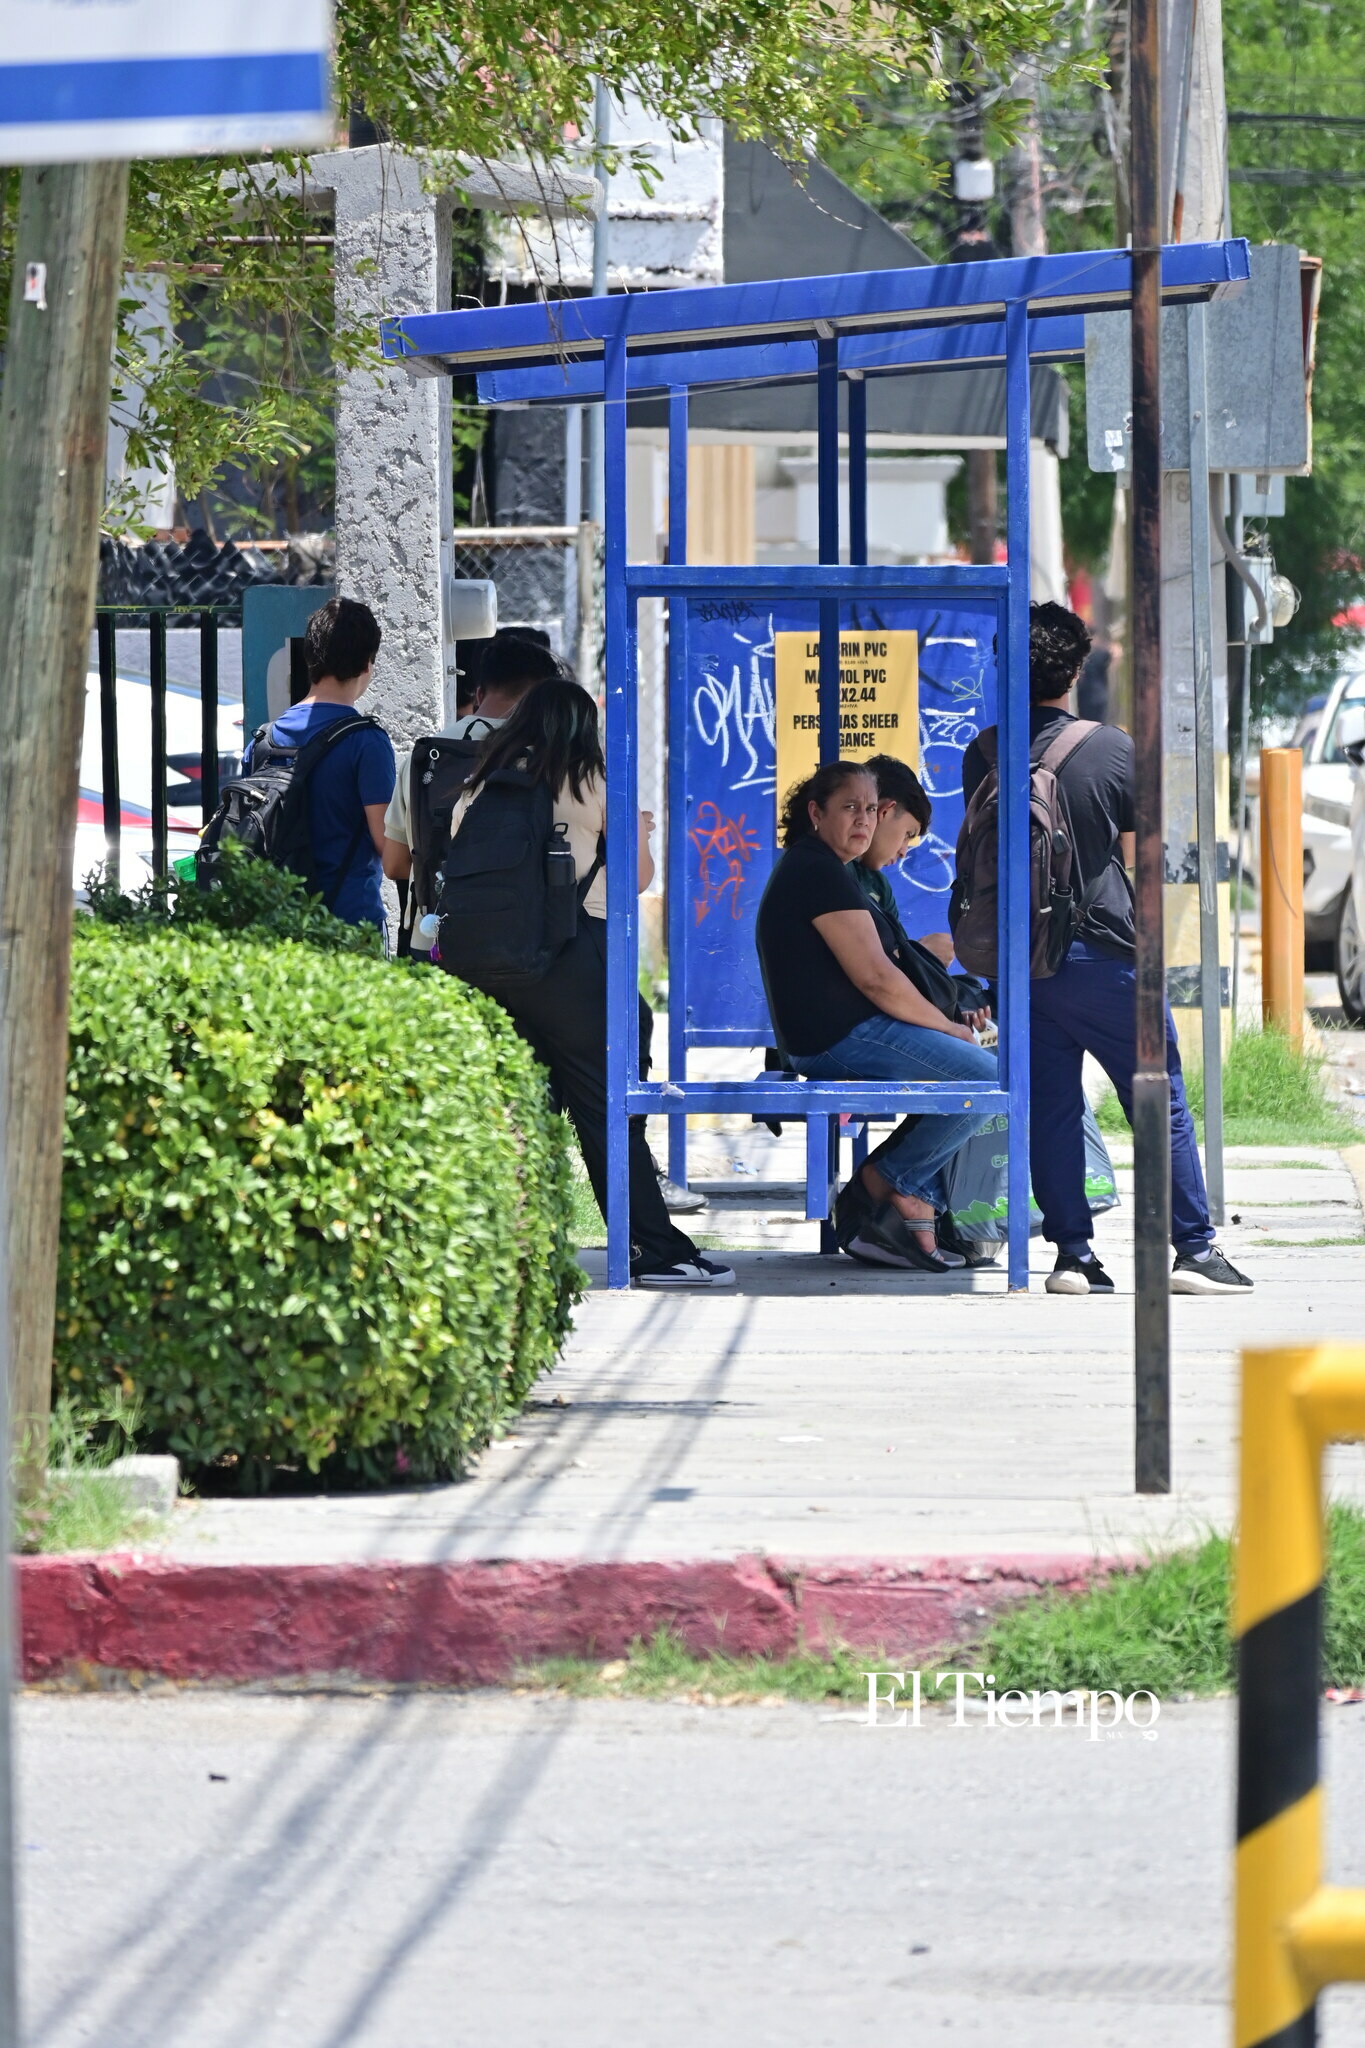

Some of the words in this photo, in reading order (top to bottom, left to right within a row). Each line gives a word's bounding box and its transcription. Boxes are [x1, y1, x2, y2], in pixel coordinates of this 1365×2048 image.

[806, 642, 860, 657] LARIN
[864, 642, 887, 657] PVC
[863, 668, 886, 684] PVC
[862, 713, 898, 728] SHEER
[817, 732, 875, 747] GANCE
